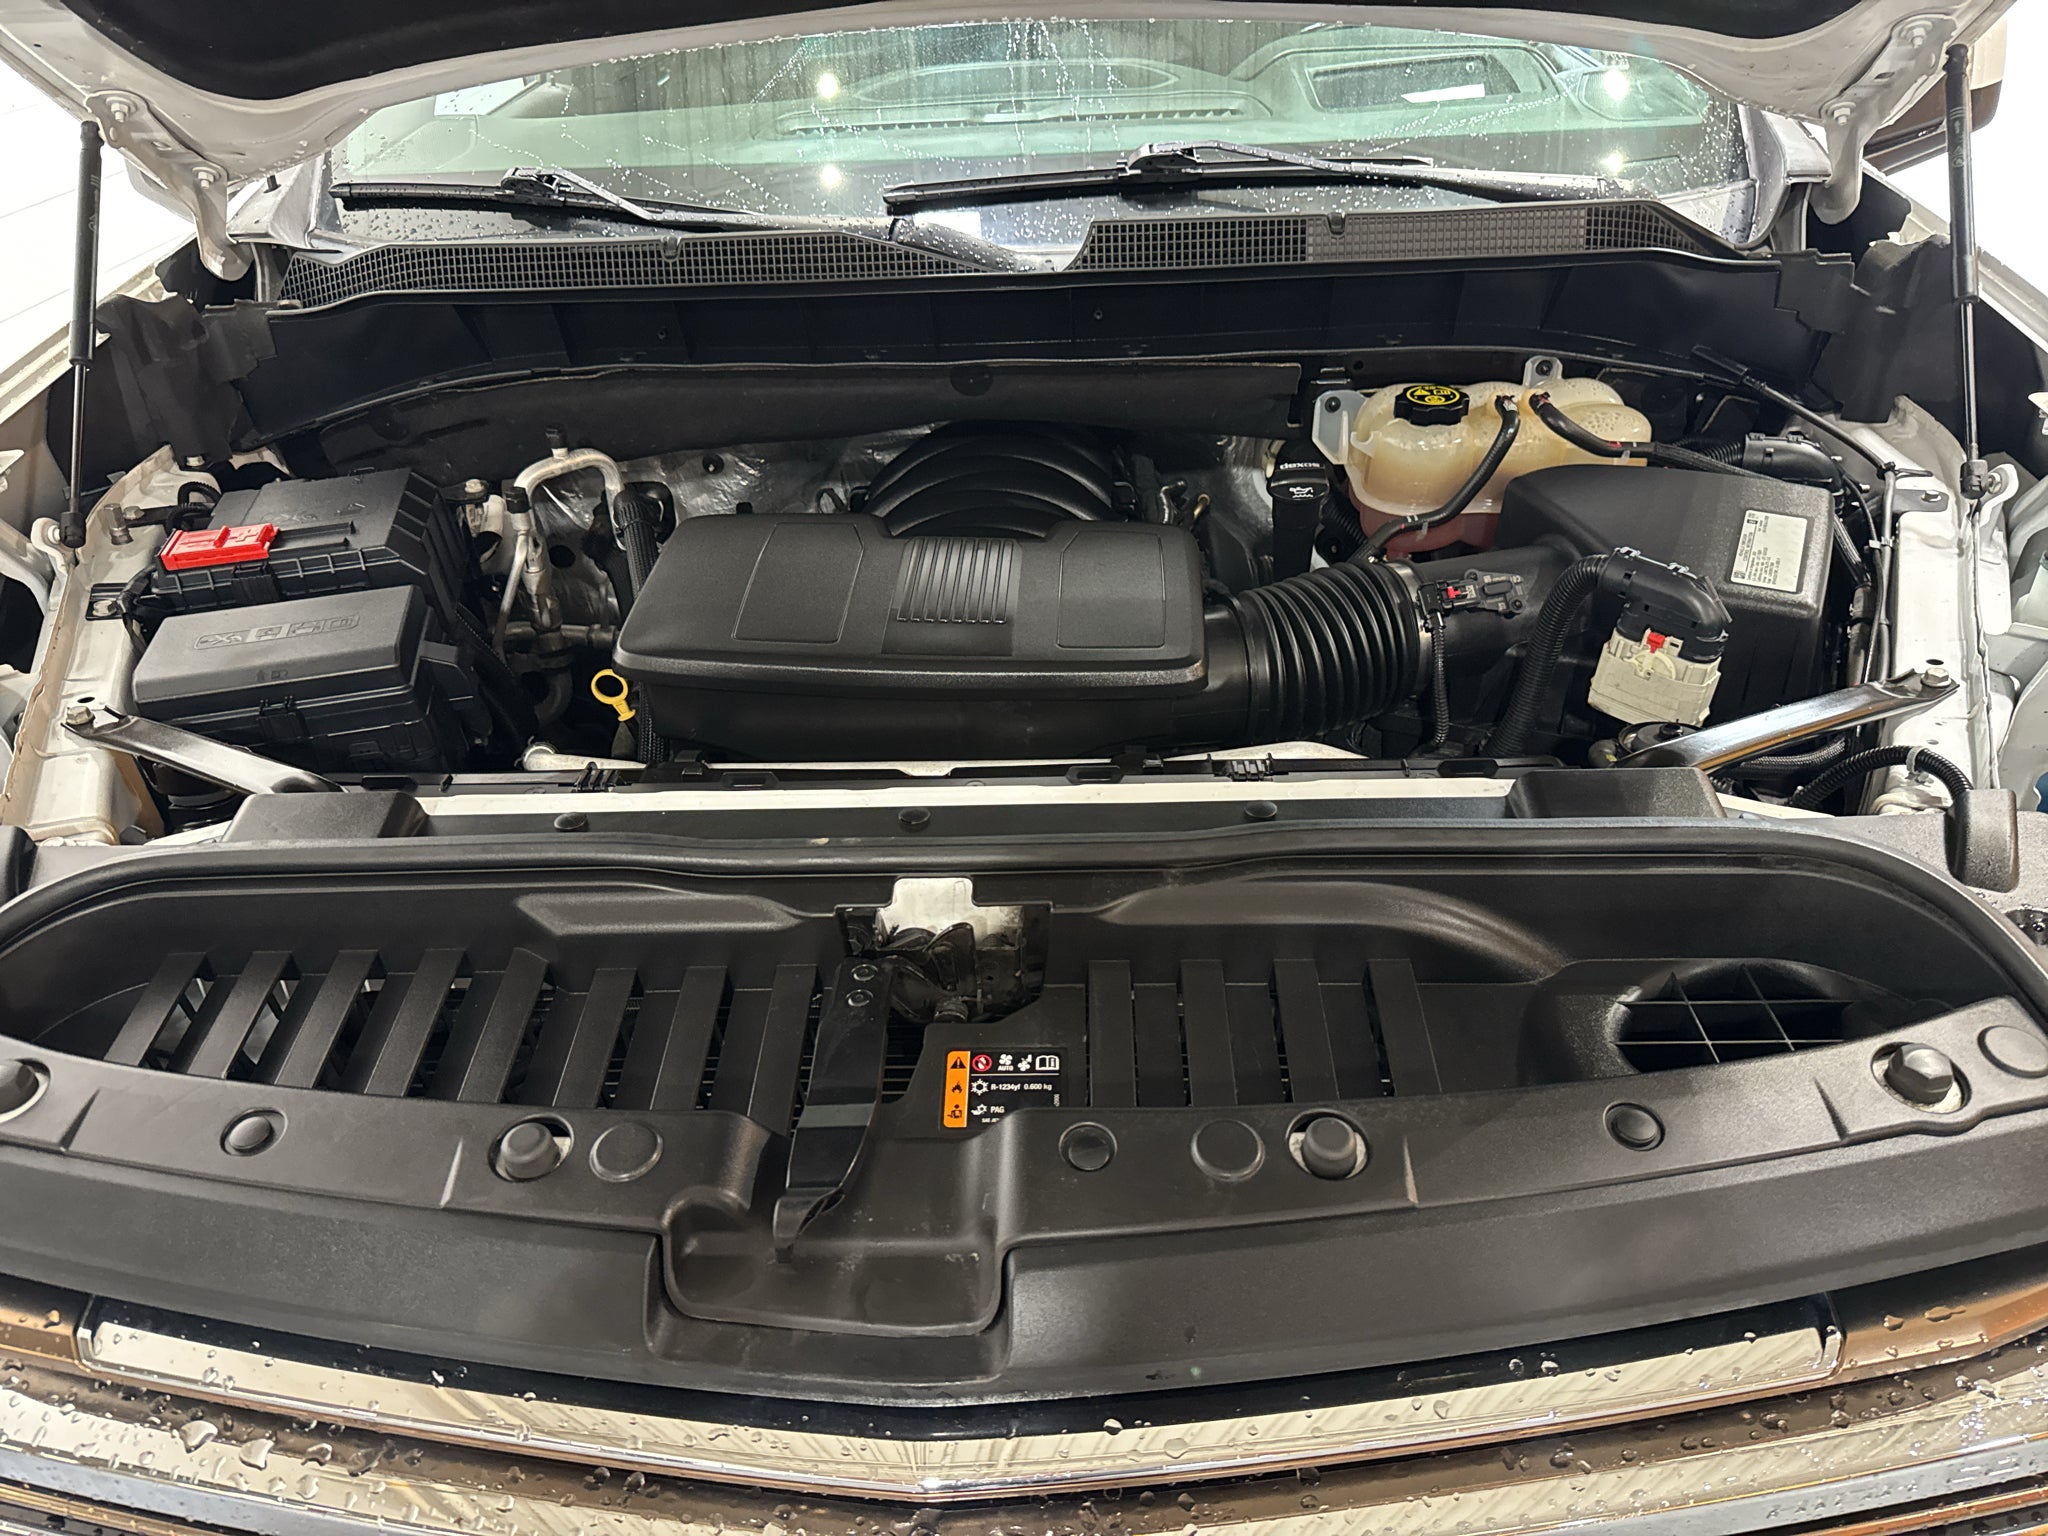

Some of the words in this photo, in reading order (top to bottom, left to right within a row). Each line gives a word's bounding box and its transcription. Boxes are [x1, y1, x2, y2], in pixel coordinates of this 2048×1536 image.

[1280, 462, 1320, 470] dexos
[990, 1083, 1021, 1091] R-1234yf
[1043, 1083, 1053, 1091] kg
[990, 1105, 1005, 1113] PAG
